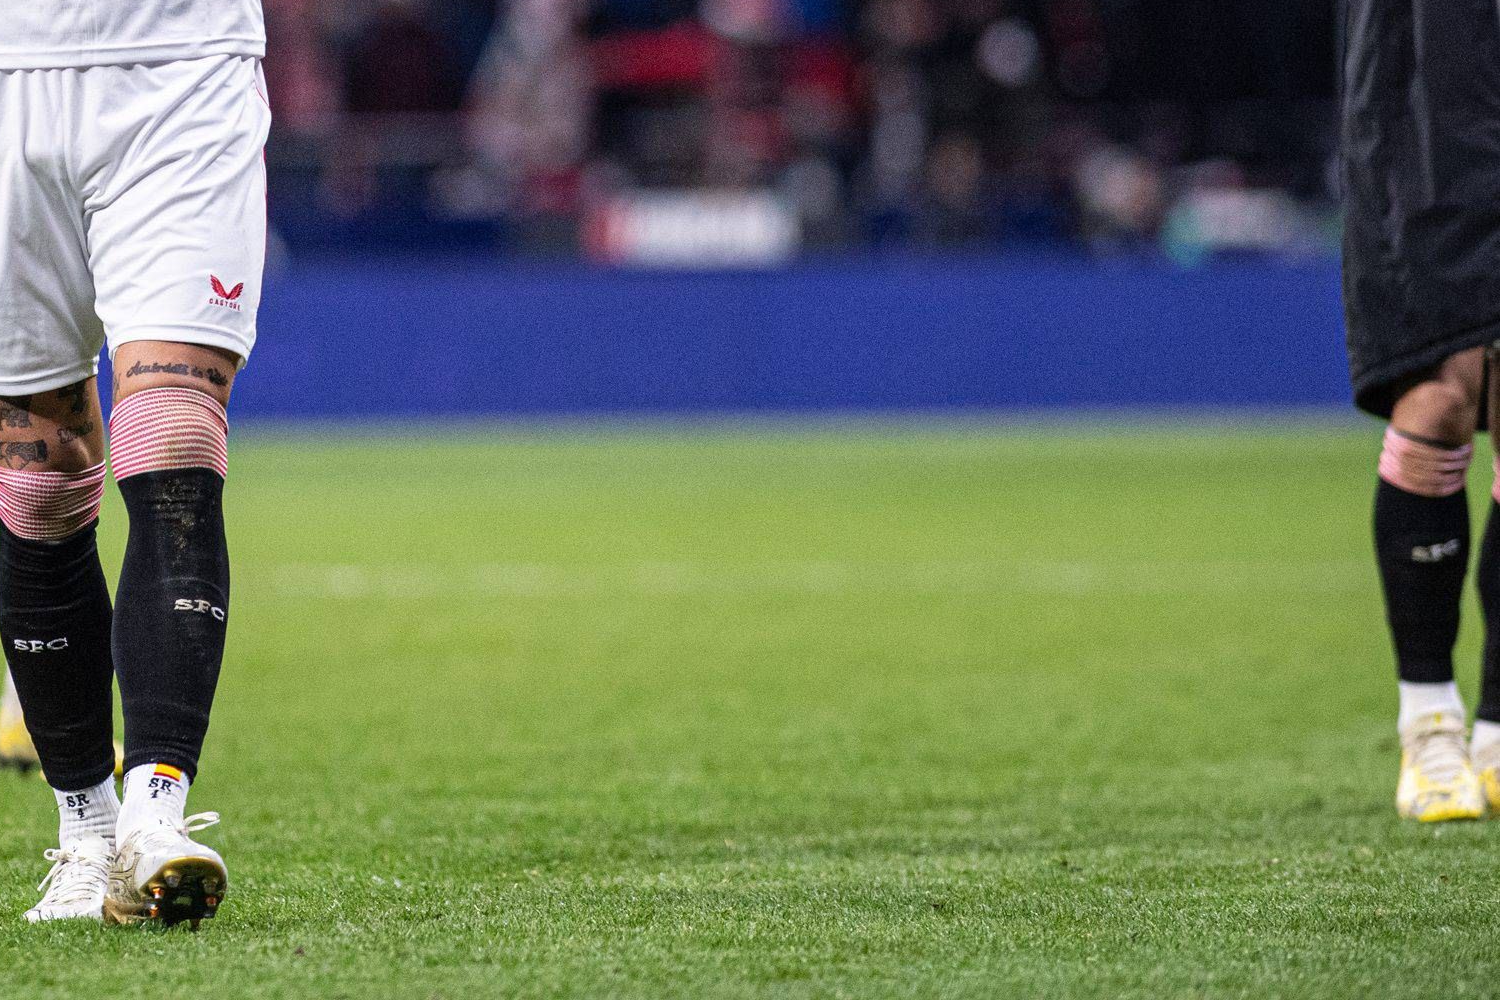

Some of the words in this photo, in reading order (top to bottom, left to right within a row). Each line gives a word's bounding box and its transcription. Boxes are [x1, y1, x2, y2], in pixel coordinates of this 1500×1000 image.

[174, 598, 225, 622] SFC
[14, 637, 69, 653] SFC
[148, 777, 172, 792] SR
[66, 793, 90, 808] SR
